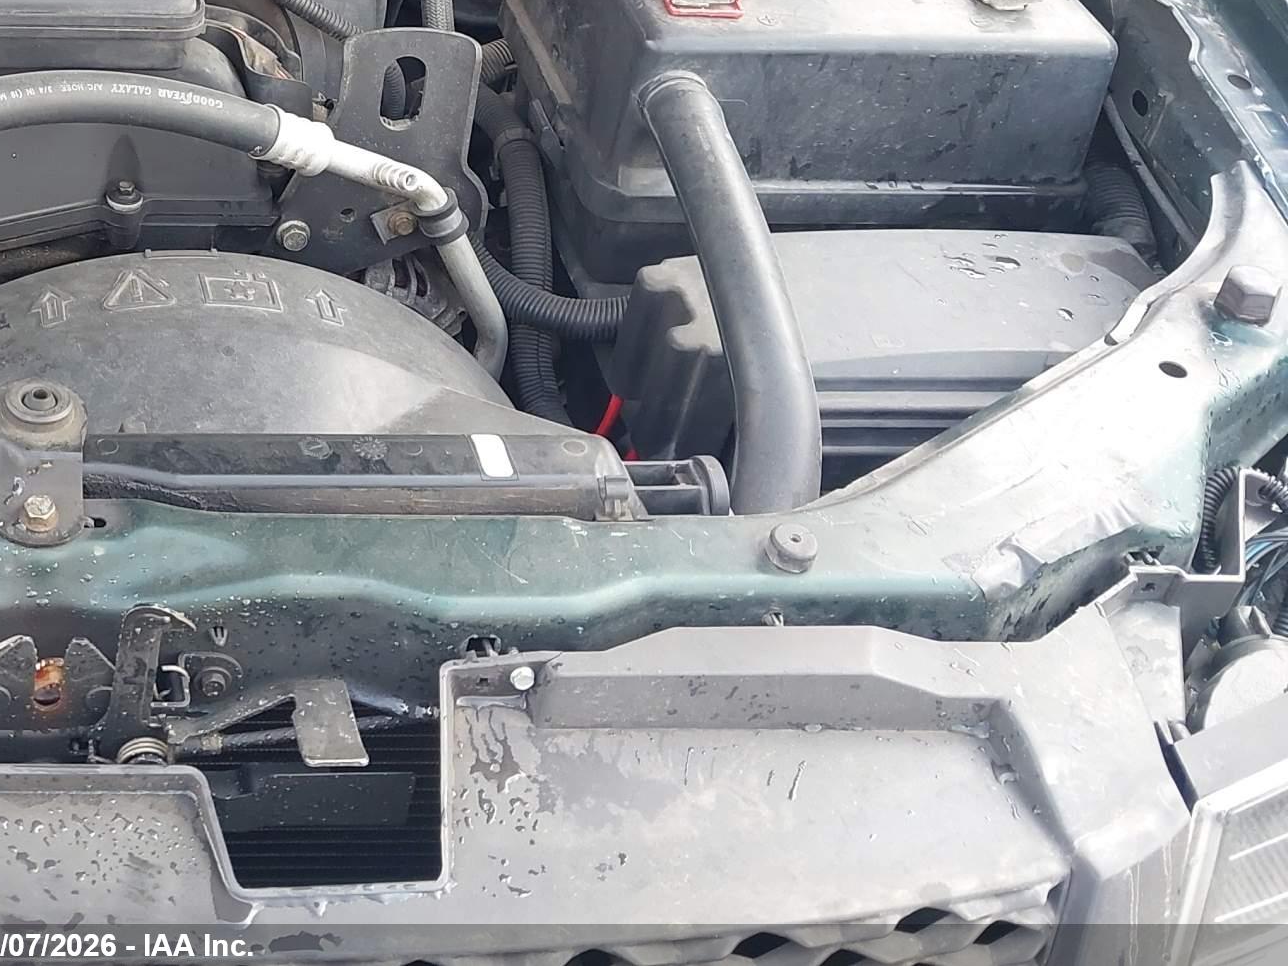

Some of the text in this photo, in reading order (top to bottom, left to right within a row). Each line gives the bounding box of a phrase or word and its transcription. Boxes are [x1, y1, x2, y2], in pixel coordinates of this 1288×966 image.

[87, 83, 103, 92] A/C
[111, 82, 152, 95] GALAXY
[158, 89, 223, 109] GOODYEAR
